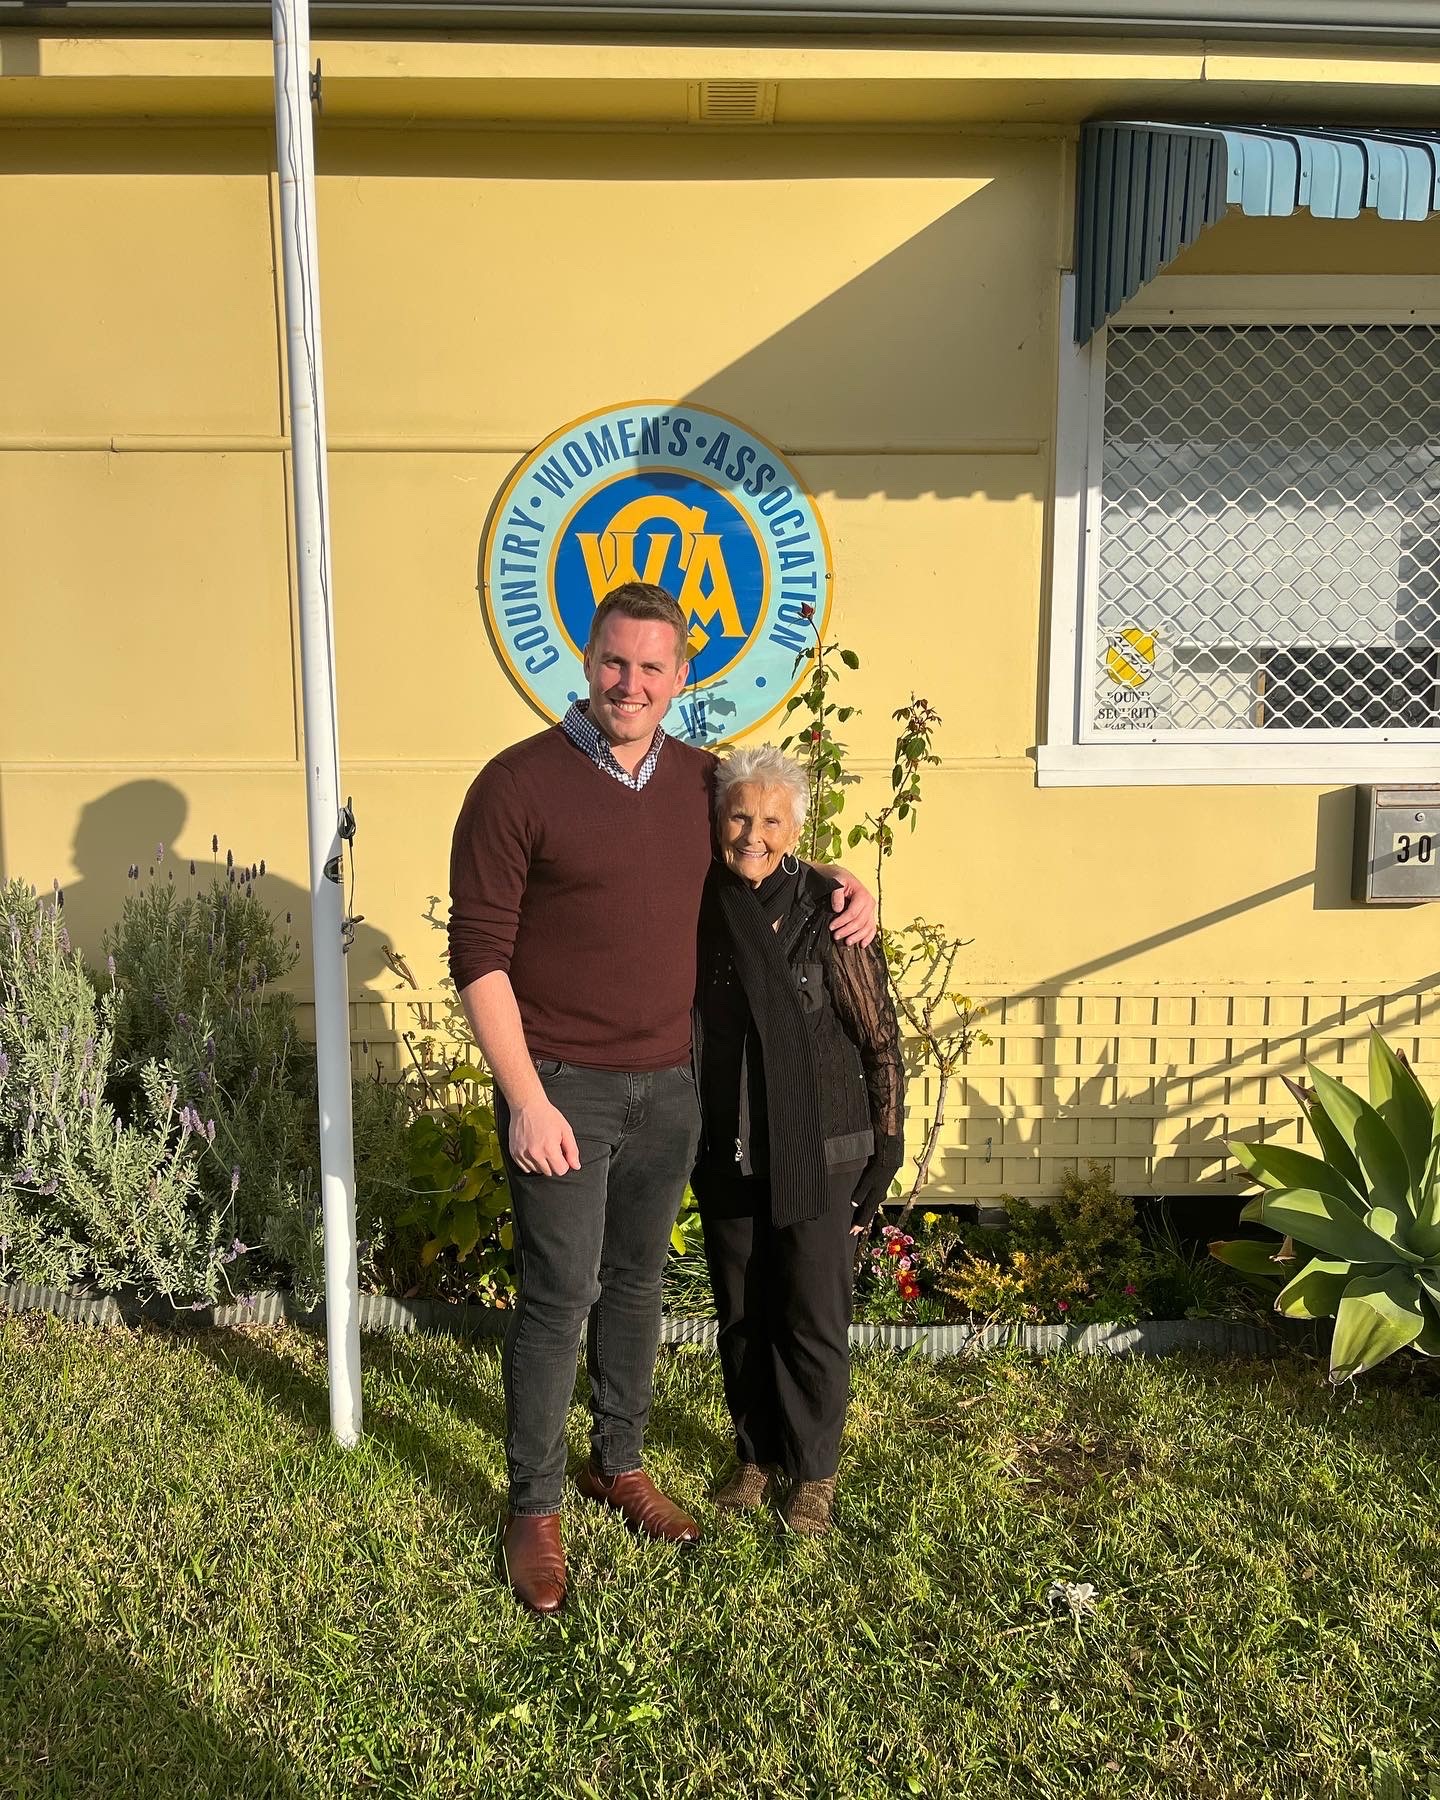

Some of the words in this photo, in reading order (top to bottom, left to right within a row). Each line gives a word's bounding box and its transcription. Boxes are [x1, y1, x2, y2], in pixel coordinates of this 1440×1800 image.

[500, 506, 560, 675] COUNTRY
[532, 416, 692, 499] WOMEN'S
[702, 431, 818, 654] ASSOCIATION
[1397, 835, 1431, 863] 30
